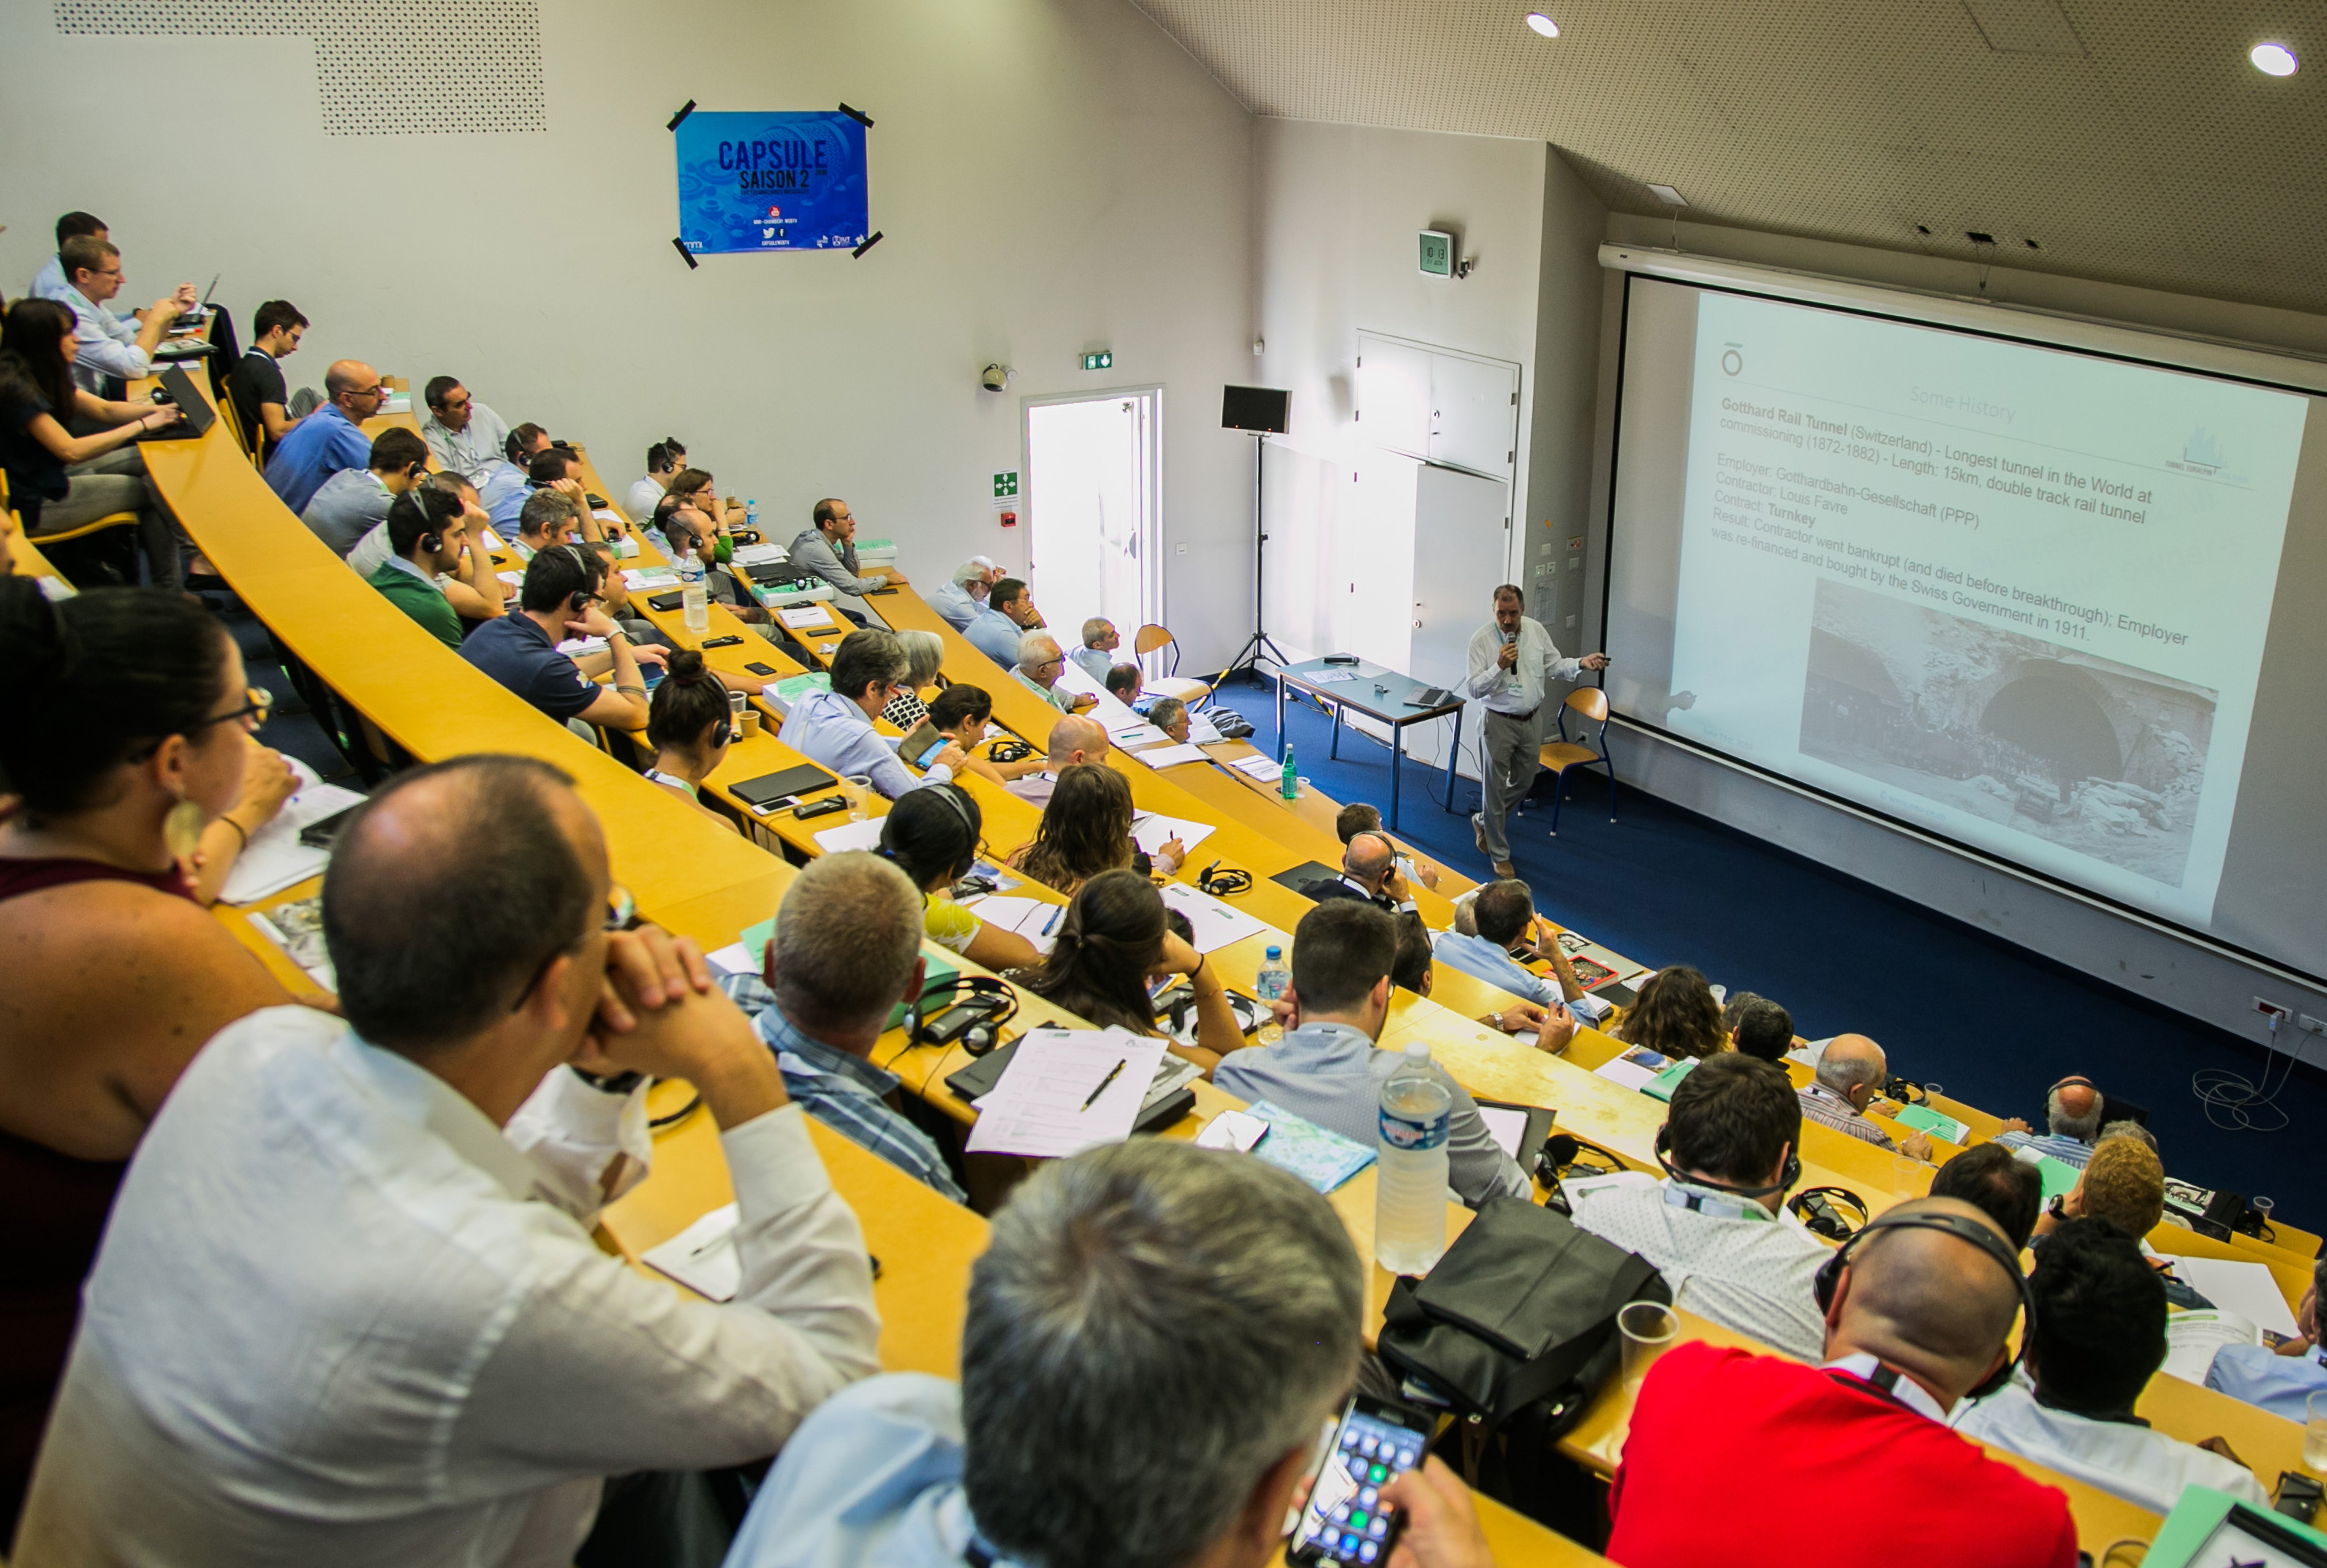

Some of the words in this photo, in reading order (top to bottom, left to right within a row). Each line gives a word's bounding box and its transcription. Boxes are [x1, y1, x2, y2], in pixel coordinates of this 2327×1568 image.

[719, 140, 826, 170] CAPSULE
[740, 170, 795, 189] SAISON
[800, 170, 809, 187] 2
[1910, 386, 1953, 409] Some
[1959, 395, 2016, 425] History
[1720, 417, 1804, 447] commissioning
[1806, 434, 1880, 465] (1872-1882)
[1892, 453, 1939, 477] Length:
[1945, 465, 1981, 488] 15km,
[1986, 476, 2032, 498] double
[2037, 487, 2070, 507] track
[2075, 498, 2097, 513] rail
[2100, 501, 2146, 524] tunnel
[1722, 398, 1774, 420] Gotthard
[1778, 409, 1801, 425] Rail
[1806, 414, 1847, 436] Tunnel
[1851, 425, 1932, 456] (Switzerland)
[1945, 444, 1999, 470] Longest
[2002, 456, 2043, 480] tunnel
[2048, 468, 2060, 482] in
[2065, 472, 2086, 491] the
[2091, 477, 2133, 499] World
[2138, 488, 2152, 504] at
[1714, 491, 1763, 513] Contract:
[1768, 503, 1816, 528] Turnkey
[1717, 452, 1772, 478] Employer:
[1777, 468, 1937, 518] Gotthardbahn-Gesellschaft
[1940, 506, 1980, 531] (PPP)
[1717, 471, 1777, 498] Contractor:
[1780, 487, 1810, 506] Louis
[1814, 496, 1848, 515] Favre
[1711, 527, 1733, 542] was
[1736, 532, 1798, 560] re-financed
[1801, 550, 1823, 567] and
[1826, 556, 1867, 579] bought
[1871, 570, 1885, 585] by
[1889, 573, 1907, 591] the
[1911, 580, 1948, 601] Swiss
[1952, 591, 2033, 626] Government
[2037, 611, 2048, 630] in
[2054, 619, 2091, 642] 1911.
[1714, 507, 1750, 528] Result:
[1755, 518, 1813, 545] Contractor
[1817, 537, 1844, 553] went
[1848, 542, 1901, 569] bankrupt
[1904, 557, 1931, 576] (and
[1936, 566, 1963, 585] died
[1967, 574, 2008, 597] before
[2013, 583, 2113, 627] breakthrough);
[2118, 614, 2189, 646] Employer
